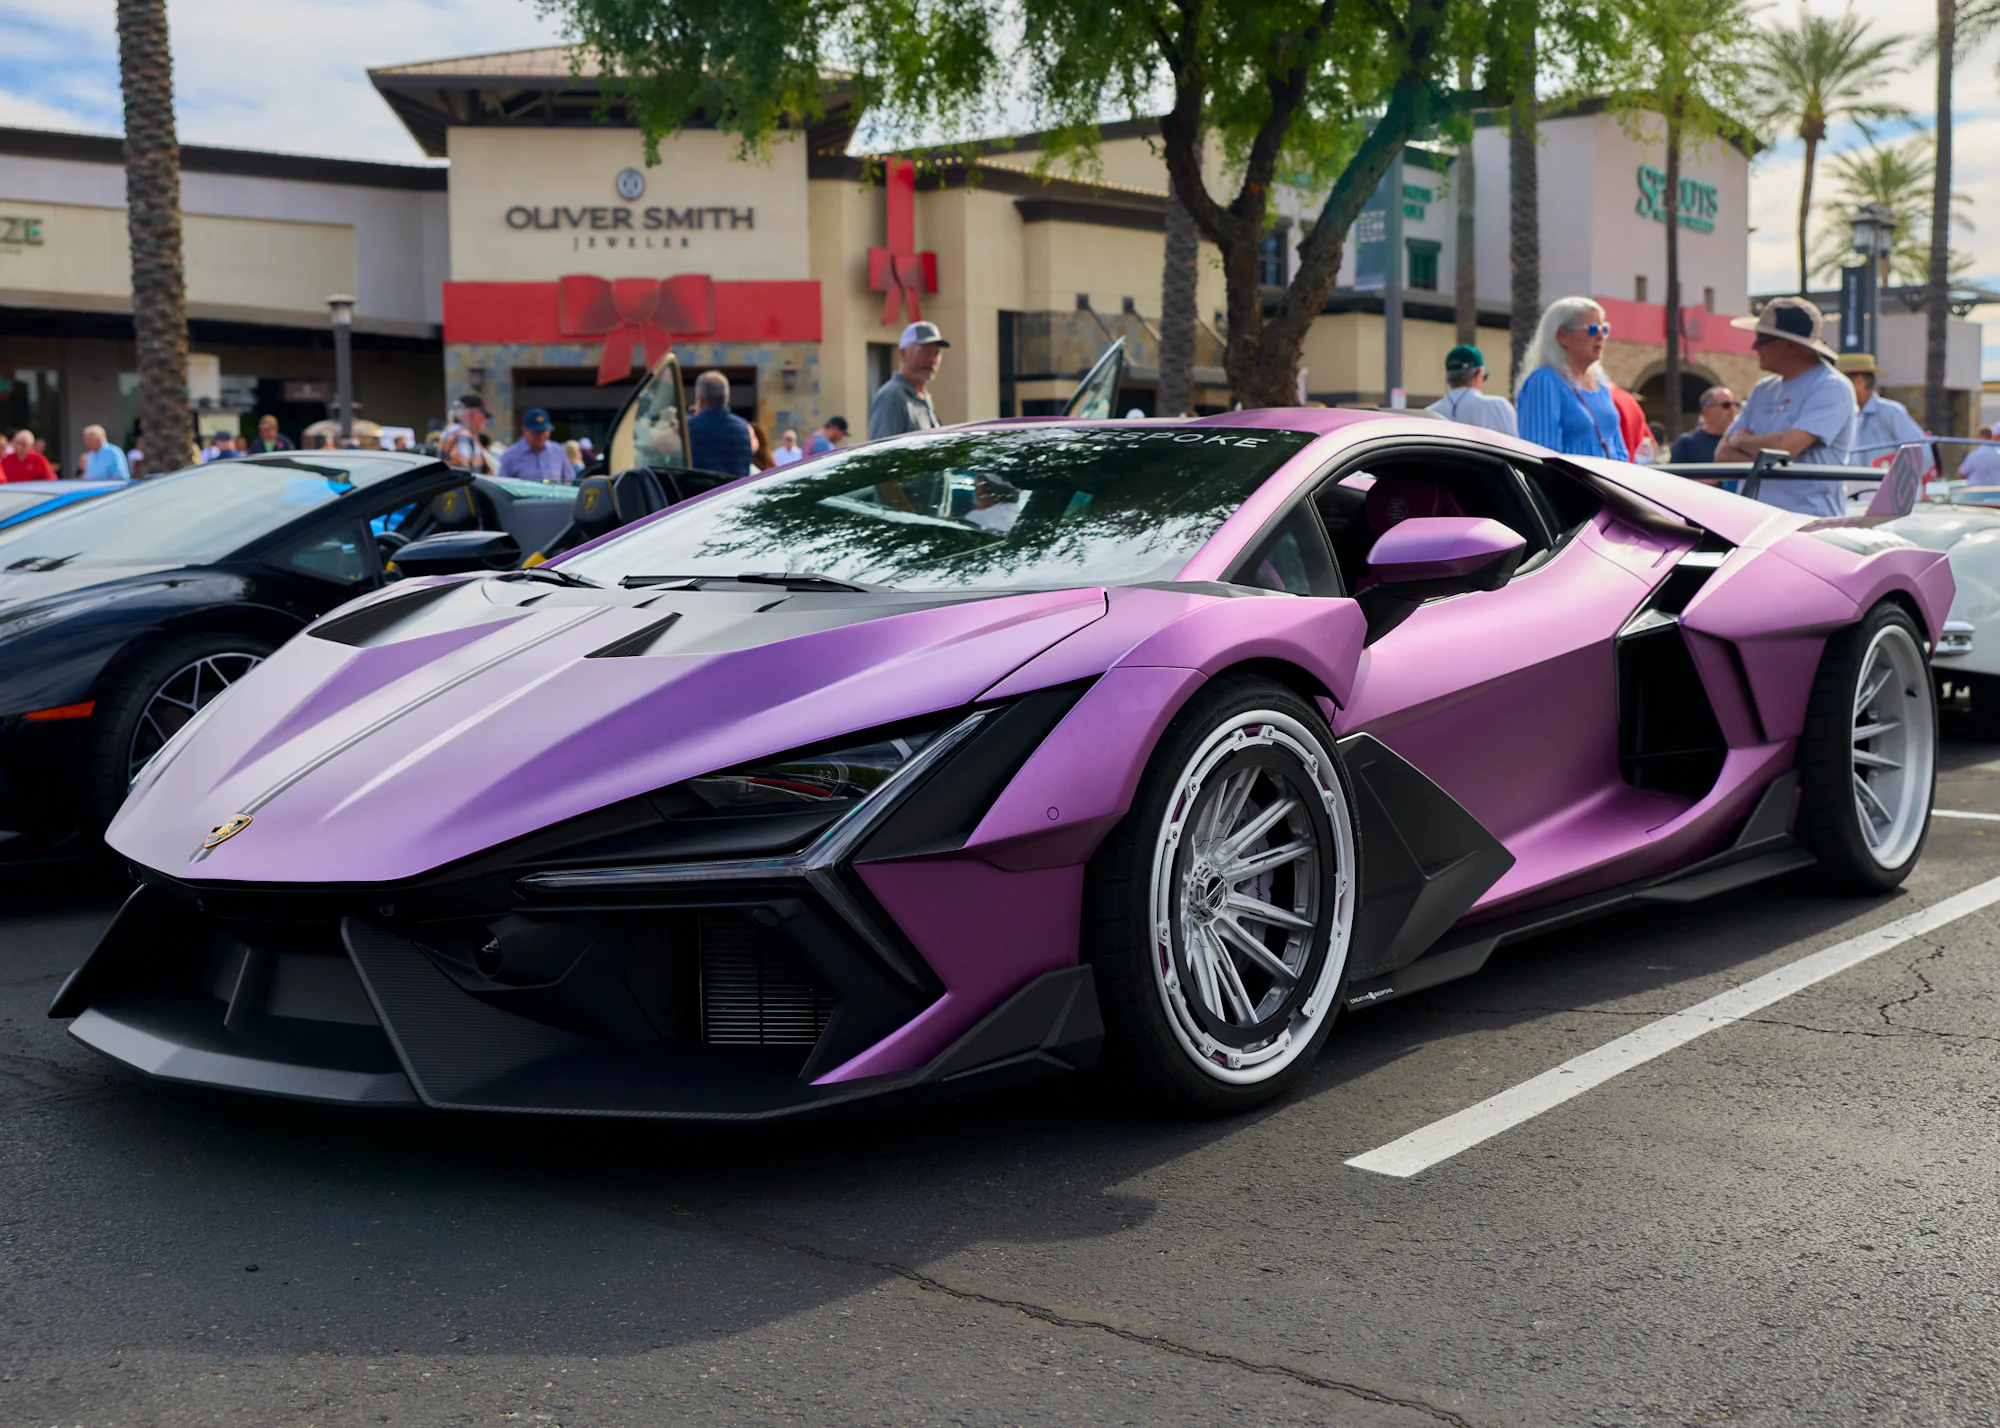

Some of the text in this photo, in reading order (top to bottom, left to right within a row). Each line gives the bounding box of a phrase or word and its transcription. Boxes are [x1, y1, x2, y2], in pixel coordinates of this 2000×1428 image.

[505, 206, 756, 230] OLIVER SMITH
[0, 216, 44, 246] ZE
[573, 236, 690, 252] JEWELER
